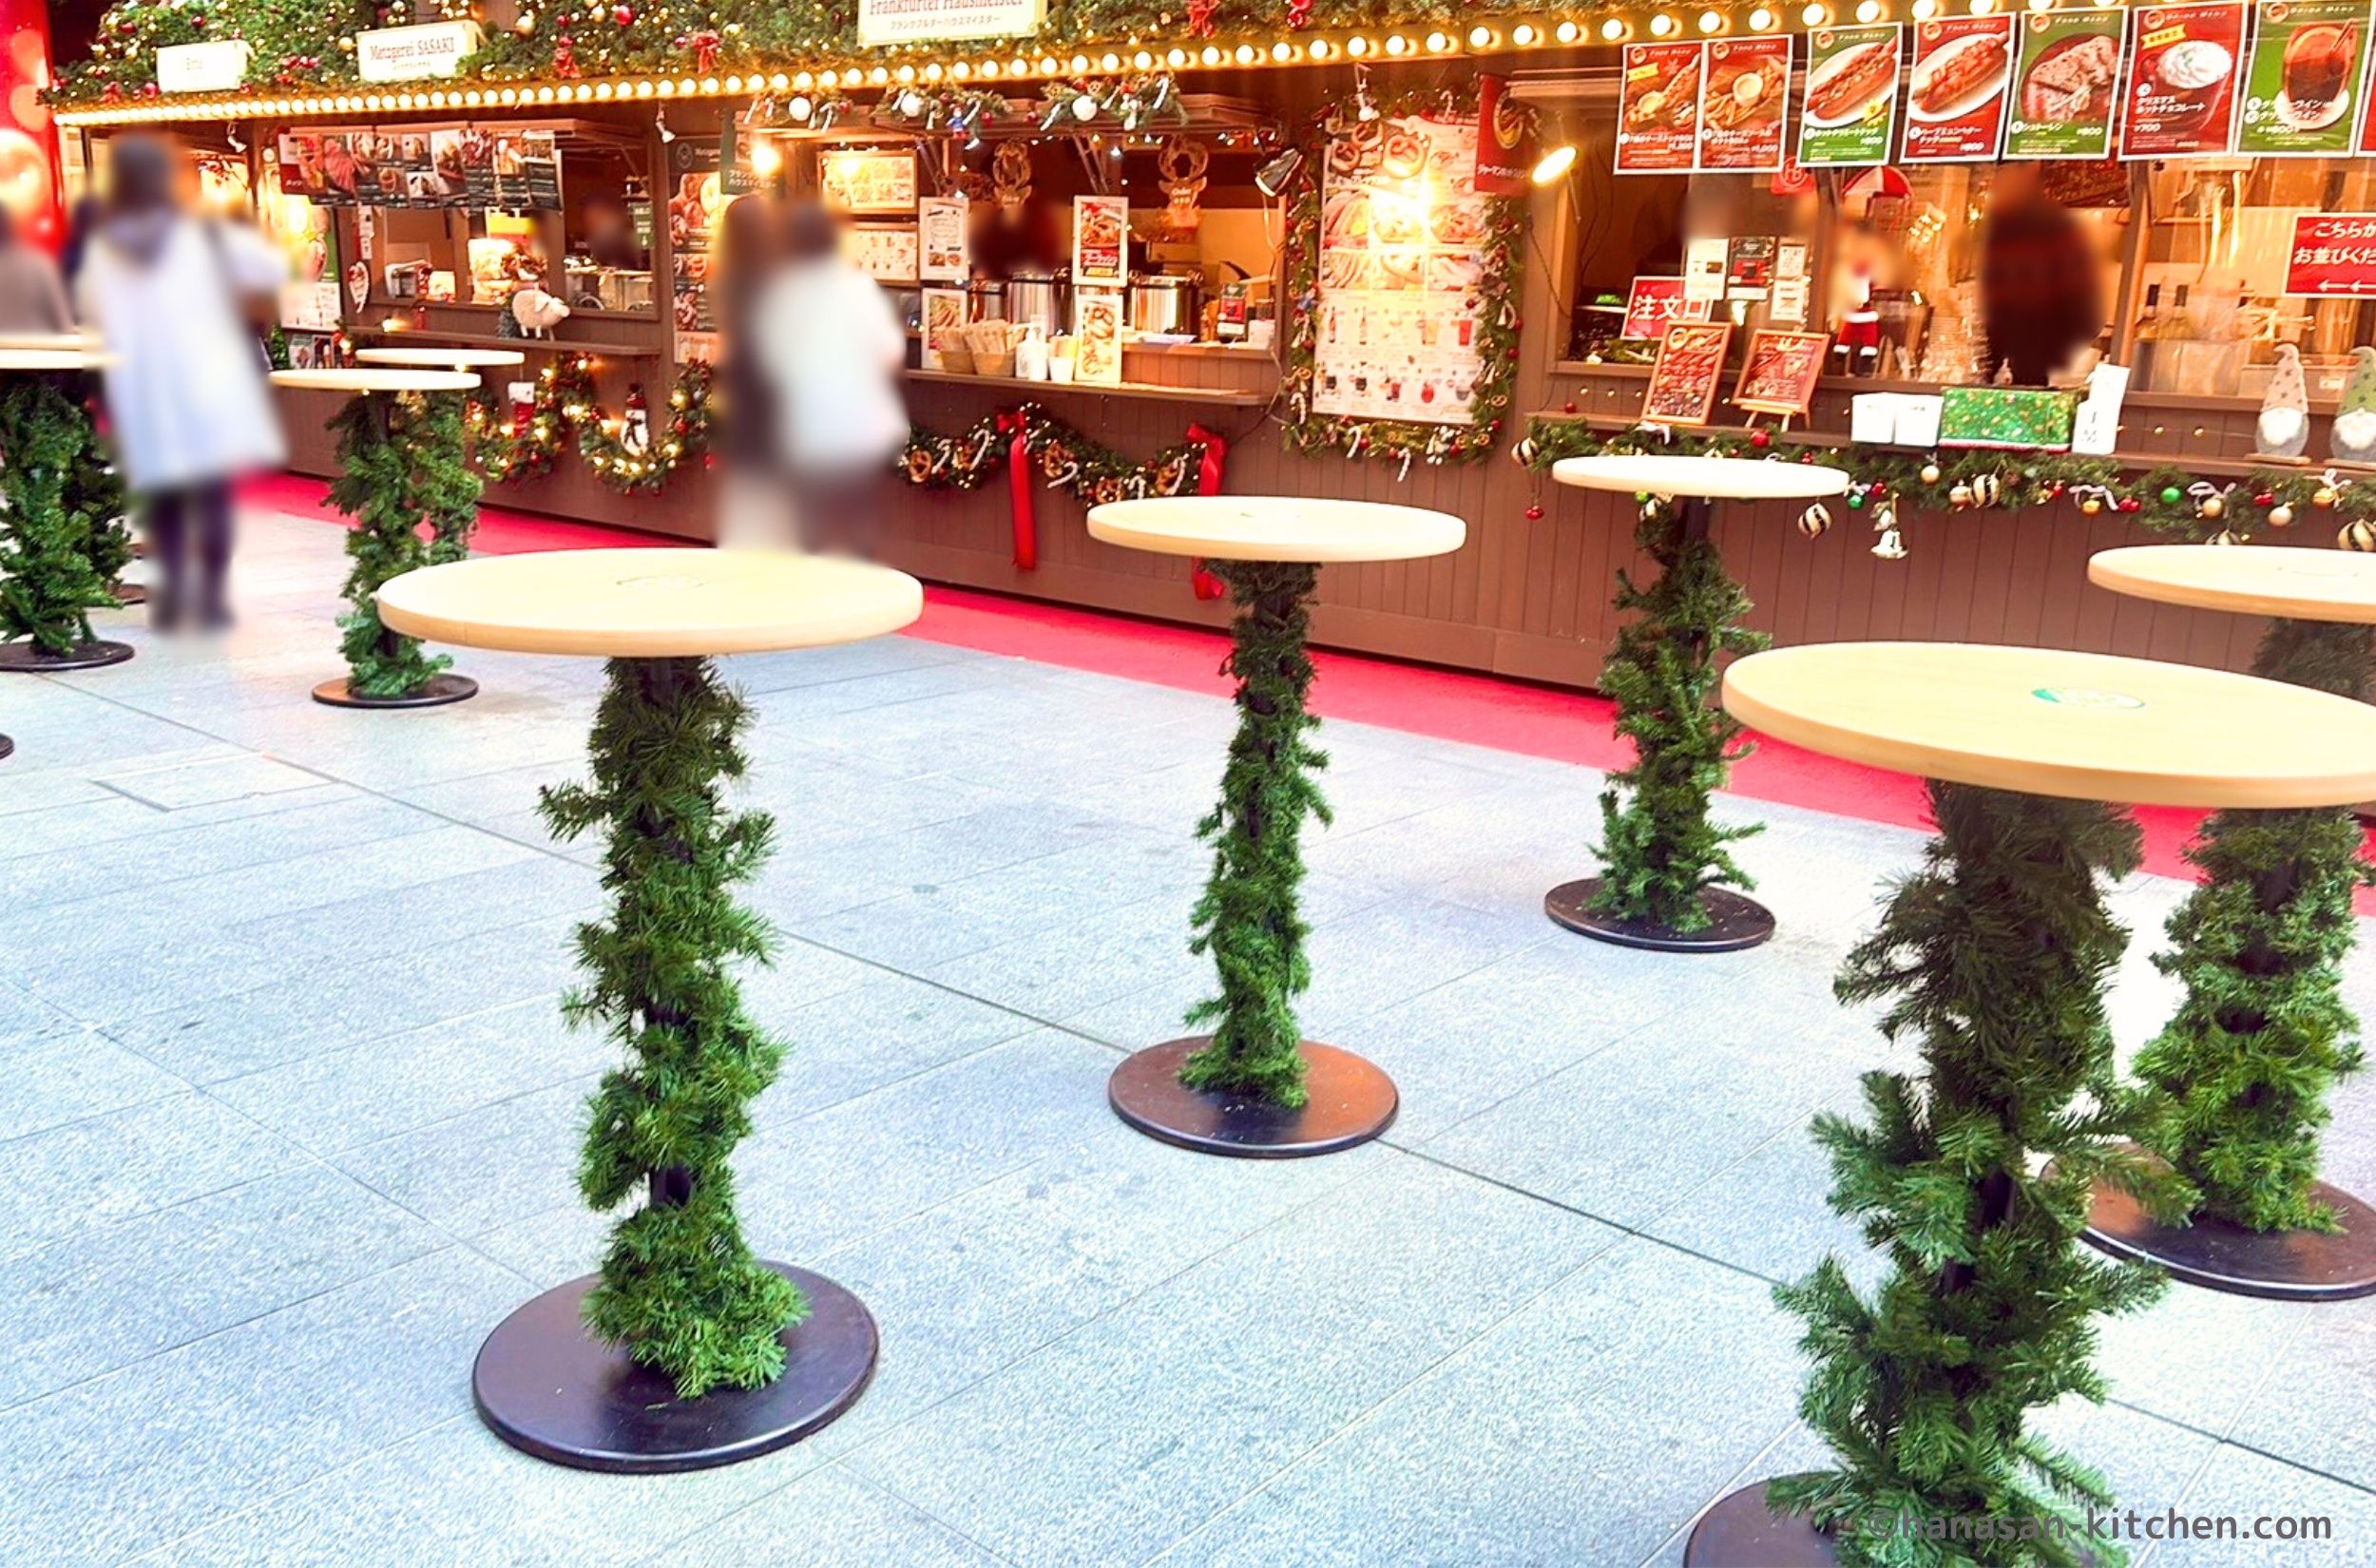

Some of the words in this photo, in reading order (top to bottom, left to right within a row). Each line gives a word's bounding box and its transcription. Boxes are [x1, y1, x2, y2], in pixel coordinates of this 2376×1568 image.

[417, 36, 454, 56] SASAKI
[1630, 295, 1708, 320] 注文口
